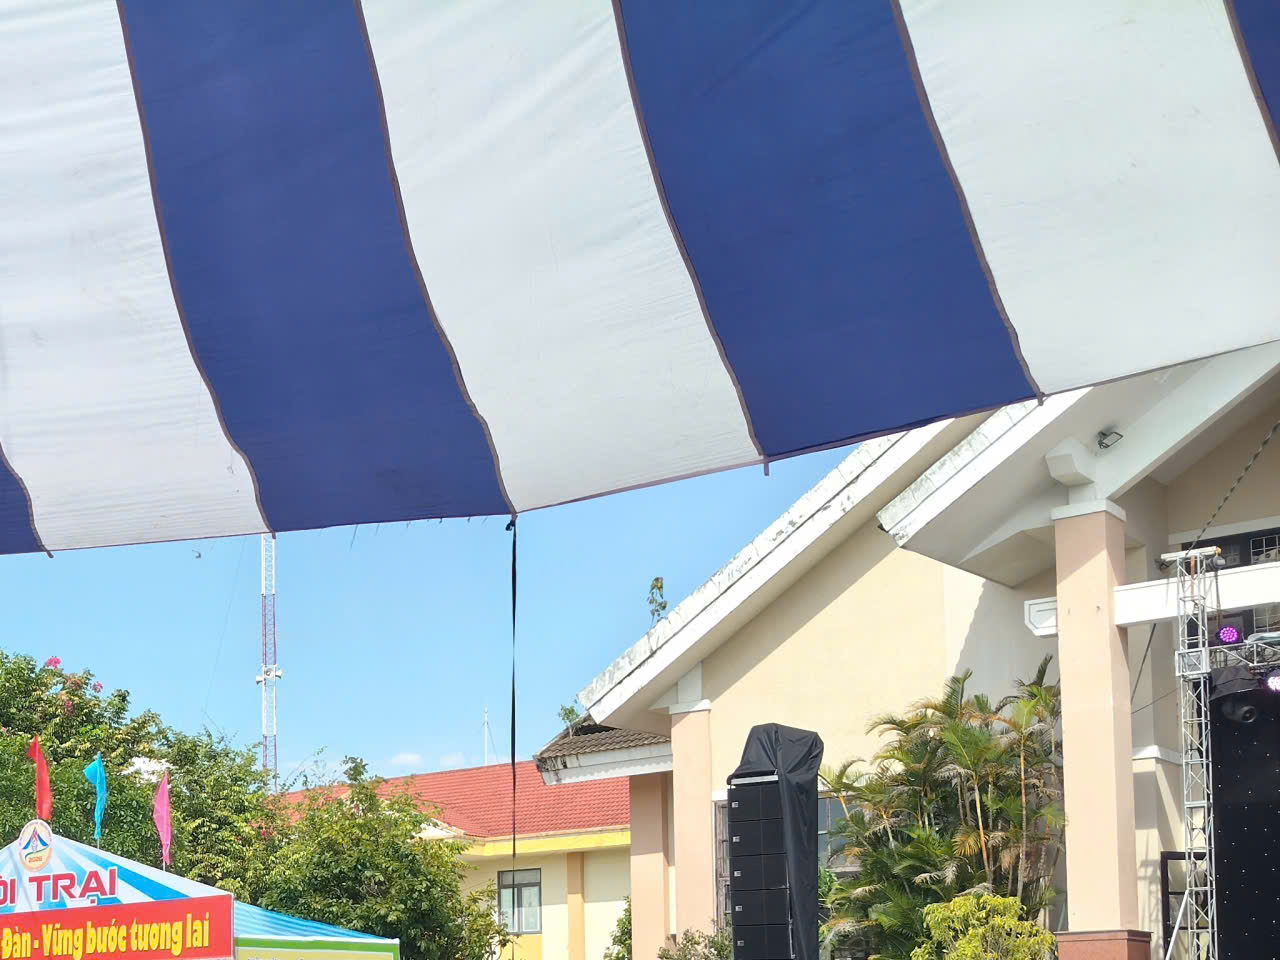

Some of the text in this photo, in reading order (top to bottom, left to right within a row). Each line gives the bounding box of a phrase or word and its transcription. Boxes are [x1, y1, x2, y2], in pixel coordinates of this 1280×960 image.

[29, 869, 118, 904] TRẠI
[2, 926, 32, 959] Đàn
[86, 919, 127, 955] bước
[130, 918, 184, 956] tương
[186, 912, 210, 948] lai
